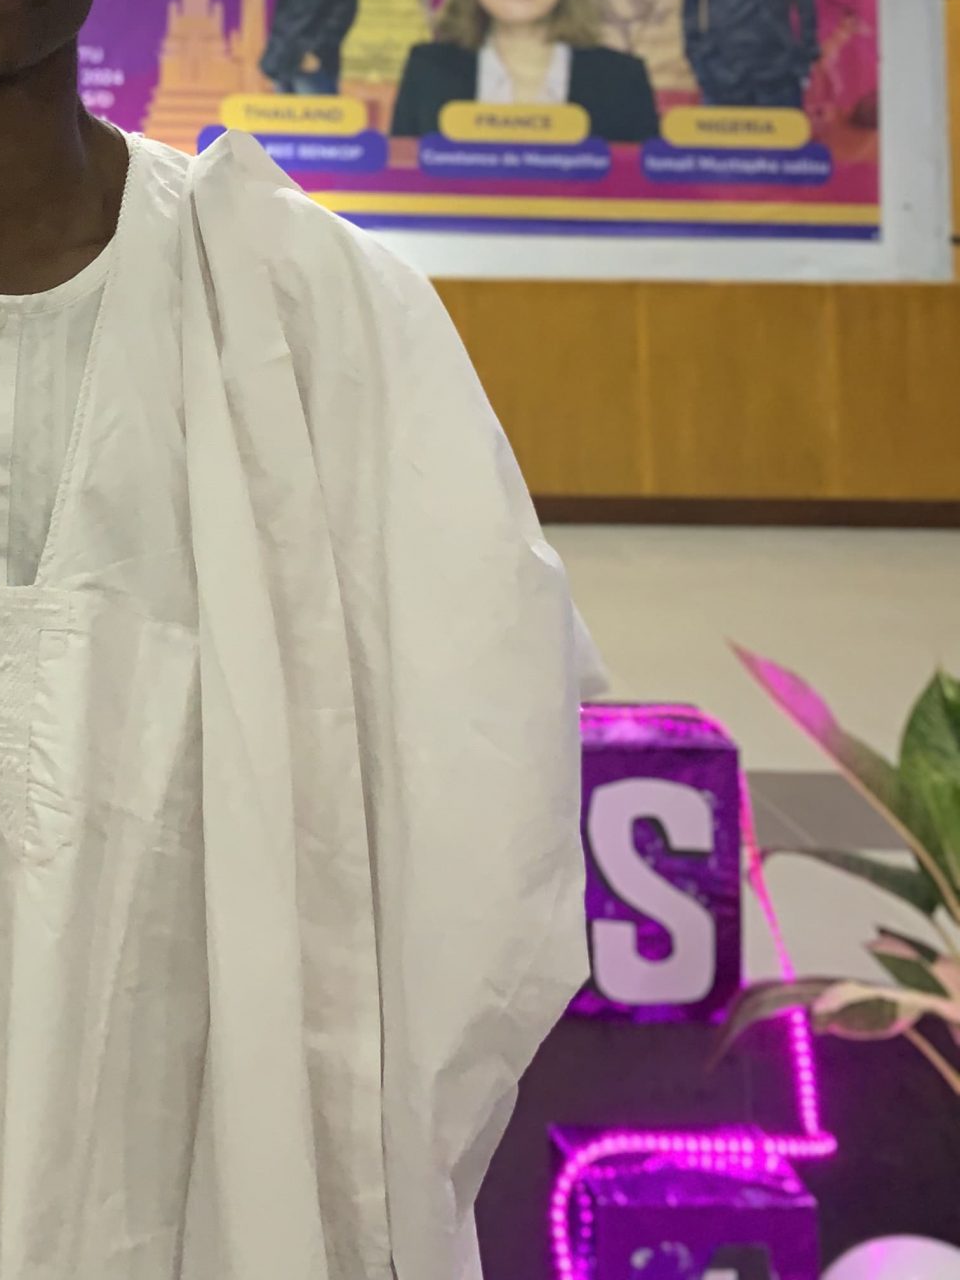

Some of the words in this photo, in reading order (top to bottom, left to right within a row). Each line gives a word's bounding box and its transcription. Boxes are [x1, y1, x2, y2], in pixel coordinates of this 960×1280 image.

[243, 104, 344, 122] THAILAND
[474, 114, 552, 130] FRANCE
[696, 118, 776, 134] NIGERIA
[587, 778, 714, 1005] S
